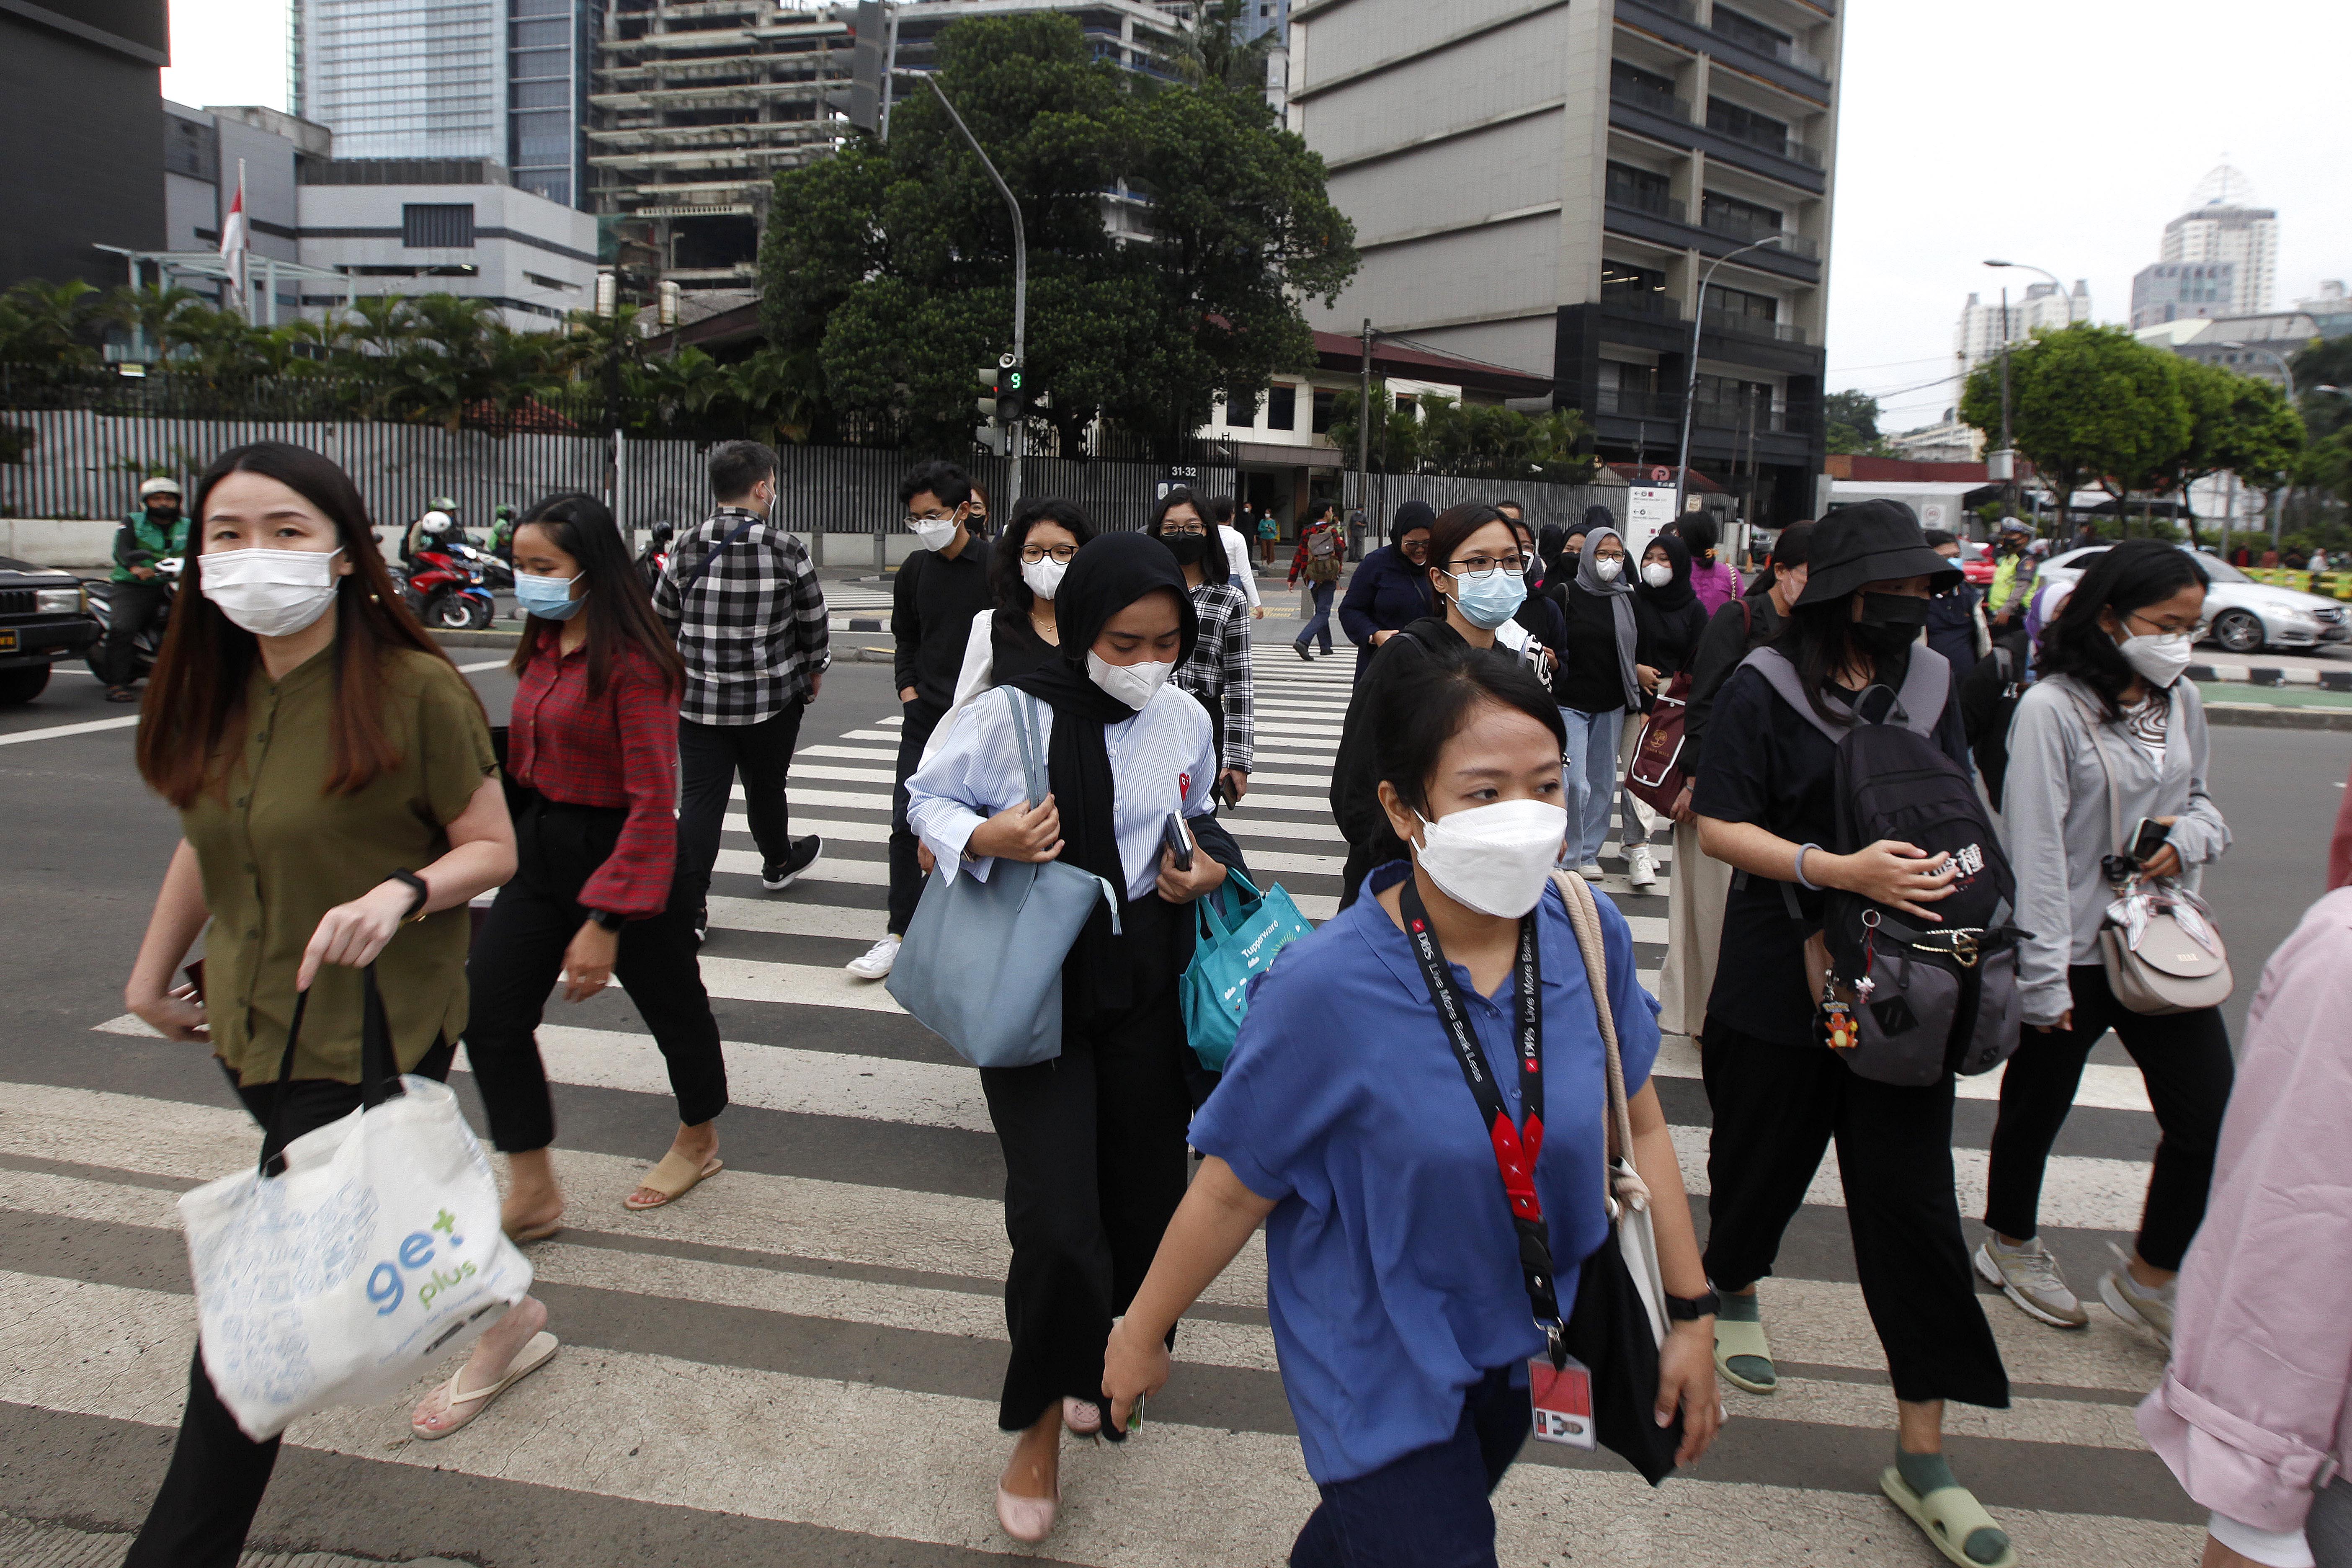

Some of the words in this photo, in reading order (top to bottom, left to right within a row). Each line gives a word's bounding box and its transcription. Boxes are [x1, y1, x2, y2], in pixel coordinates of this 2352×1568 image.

[1011, 373, 1021, 389] 9
[1241, 920, 1279, 957] Tupperware
[1522, 934, 1532, 962] Bank
[1523, 964, 1535, 995] More
[1417, 931, 1436, 961] DBS
[1429, 963, 1444, 989] Live
[1439, 988, 1457, 1021] More
[1452, 1020, 1472, 1052] Bank
[1466, 1052, 1483, 1083] Less
[1524, 997, 1536, 1023] Live
[1524, 1027, 1536, 1057] DBS
[419, 1260, 477, 1310] plus
